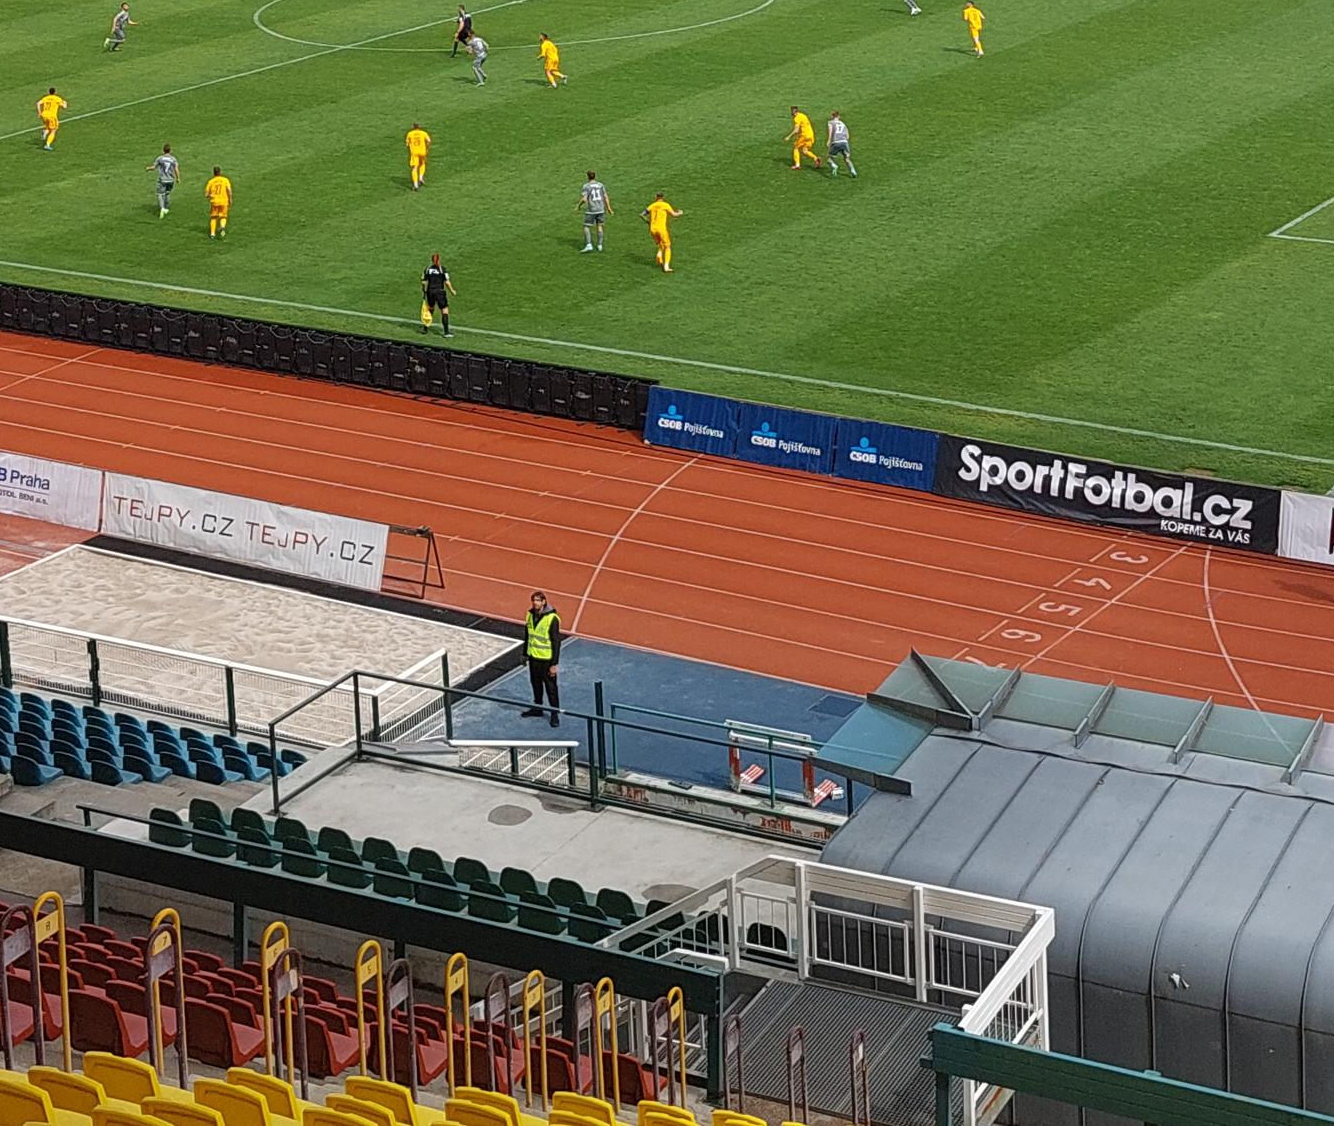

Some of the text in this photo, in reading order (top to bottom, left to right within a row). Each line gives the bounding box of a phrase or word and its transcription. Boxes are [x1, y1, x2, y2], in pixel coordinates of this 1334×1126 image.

[778, 439, 821, 457] Pojišťovna
[878, 454, 924, 473] Pojišťovna
[9, 470, 50, 490] Praha
[958, 444, 1254, 531] SportFotbal.cz
[113, 494, 376, 566] TEJPY.CZ TEJPY.CZ
[1160, 518, 1251, 544] KOPEME ZA VÁS
[1109, 550, 1149, 565] 3
[1039, 601, 1083, 616] 5
